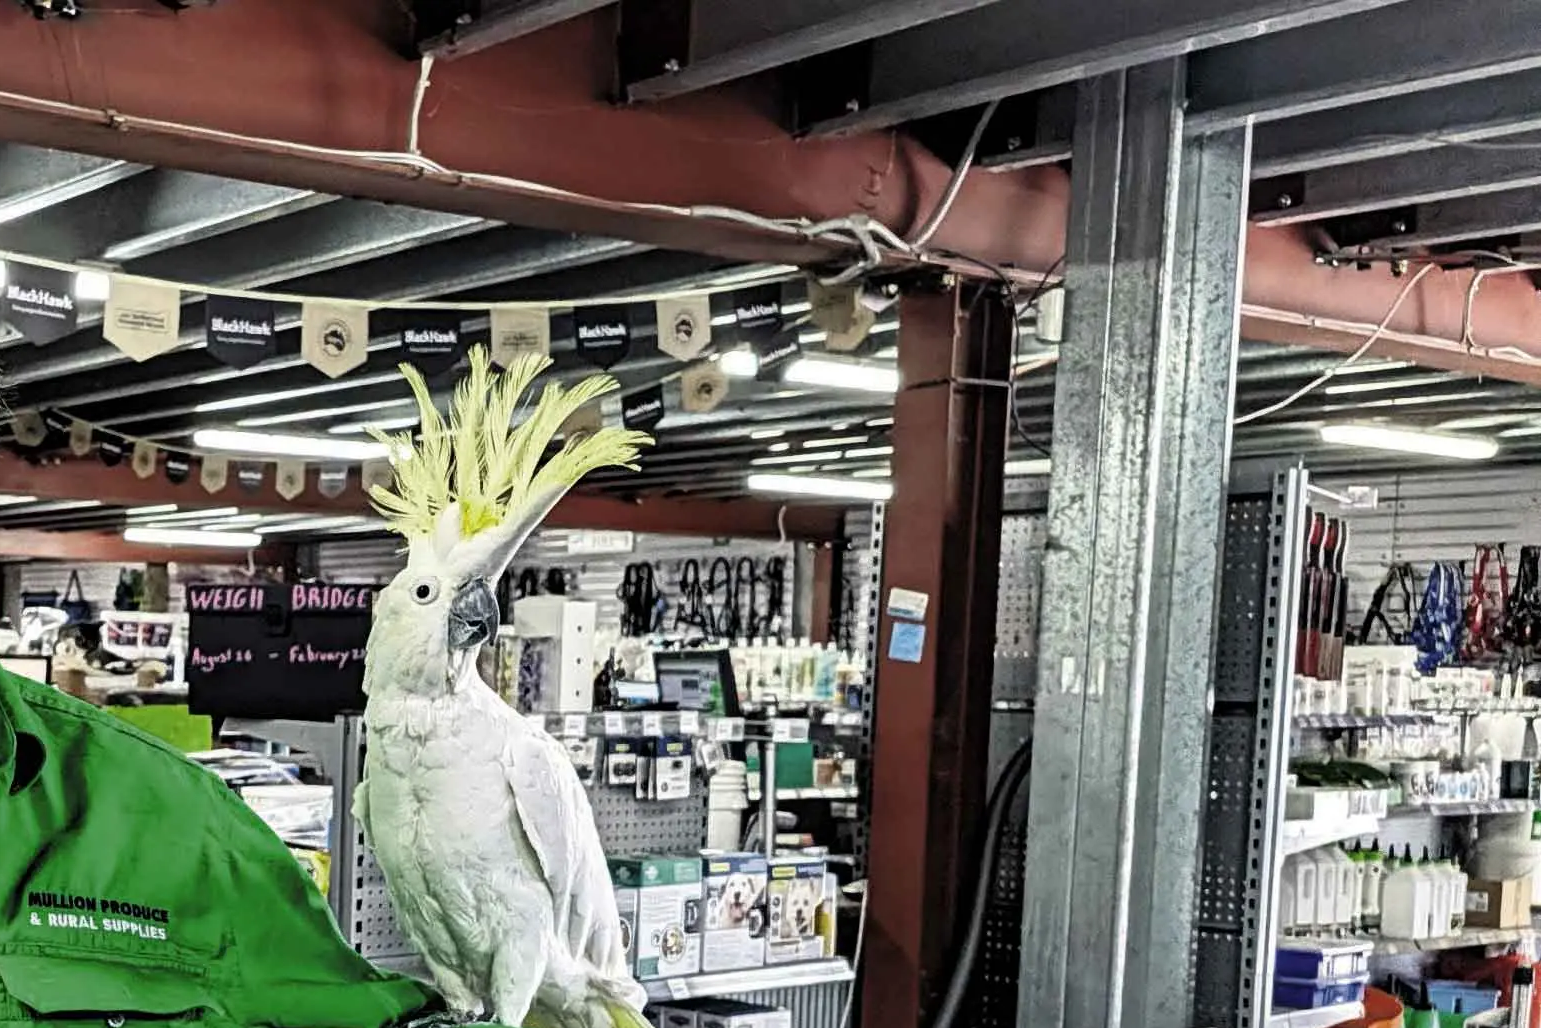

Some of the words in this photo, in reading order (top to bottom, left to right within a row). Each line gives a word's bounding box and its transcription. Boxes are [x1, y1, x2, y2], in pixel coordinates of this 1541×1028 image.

[191, 587, 263, 610] WEIGH
[291, 584, 367, 611] BRIDGE
[192, 648, 232, 672] August
[289, 642, 349, 669] February
[28, 892, 96, 912] MULLION
[100, 899, 170, 923] PRODUCE
[30, 911, 42, 926] &
[48, 912, 98, 930] RURAL
[102, 918, 167, 940] SUPPLIES
